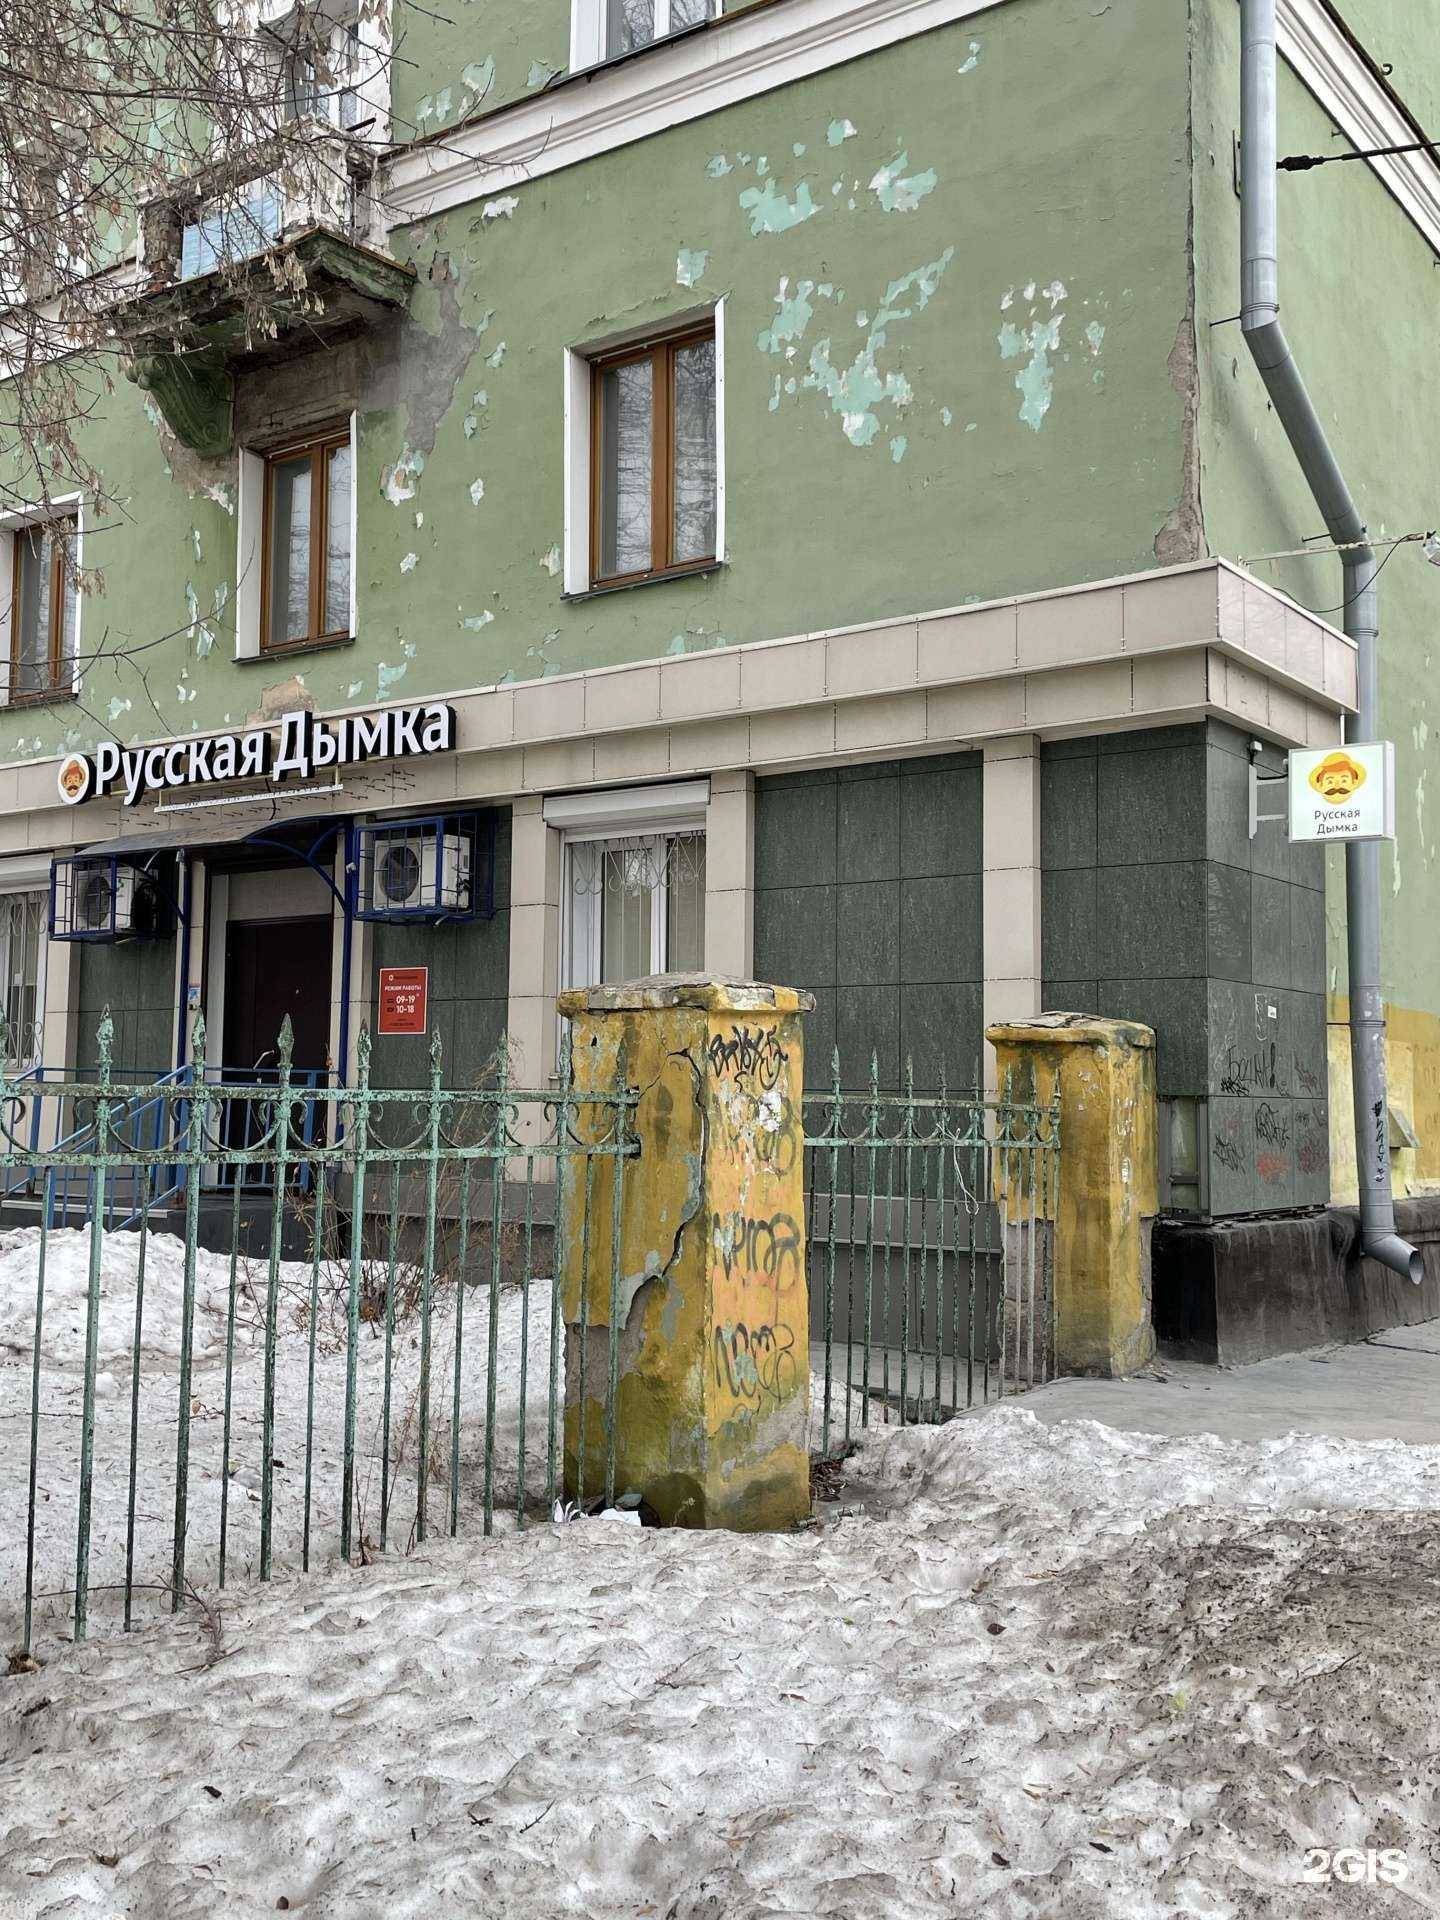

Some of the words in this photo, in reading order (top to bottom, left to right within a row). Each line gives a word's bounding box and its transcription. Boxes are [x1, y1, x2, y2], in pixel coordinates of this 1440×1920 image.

[95, 731, 269, 804] Русская
[272, 702, 454, 782] Дымка
[1314, 809, 1361, 821] Русская
[1317, 823, 1358, 835] Дымка
